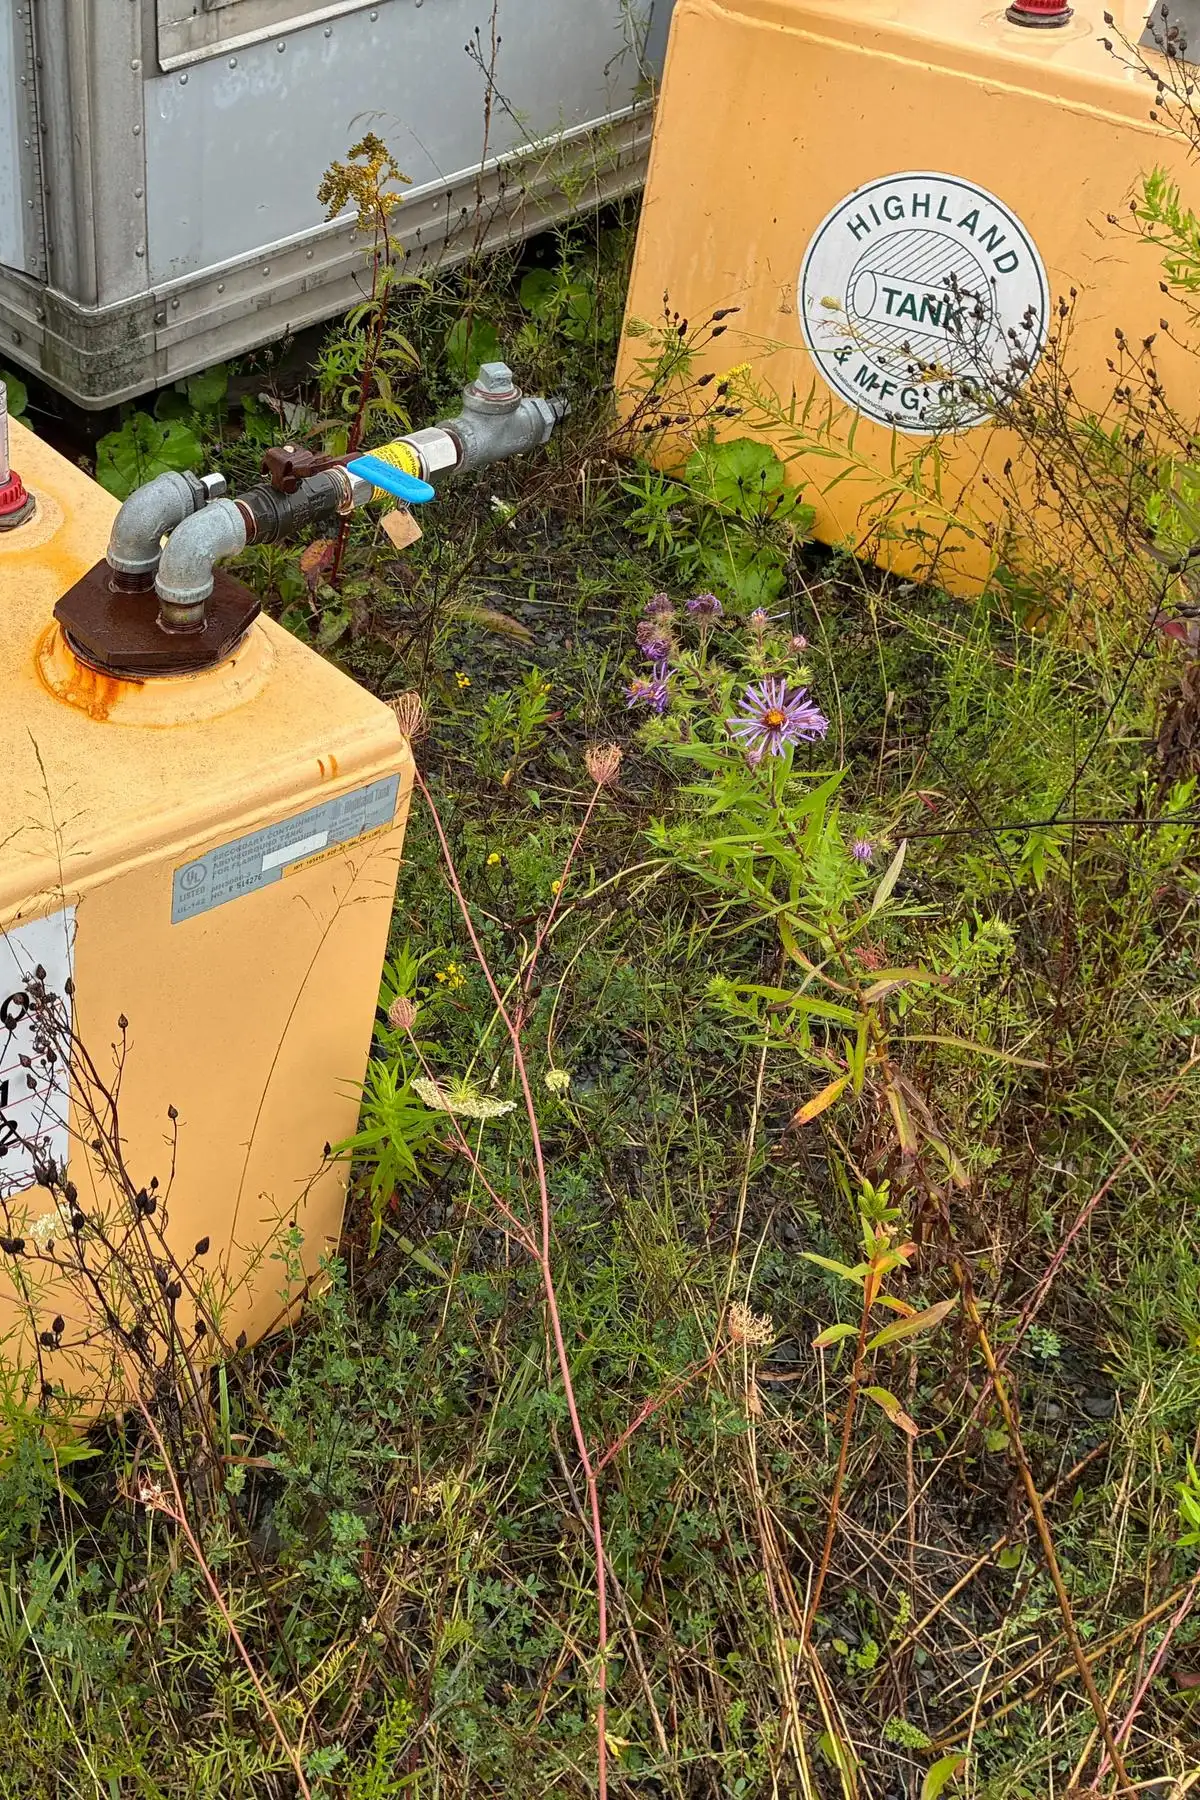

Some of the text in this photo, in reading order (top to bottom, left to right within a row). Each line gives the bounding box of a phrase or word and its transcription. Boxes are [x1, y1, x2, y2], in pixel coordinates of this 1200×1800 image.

[846, 192, 1020, 274] HIGHLAND
[881, 286, 961, 330] TANK
[833, 345, 853, 366] &
[179, 886, 205, 903] LISTED
